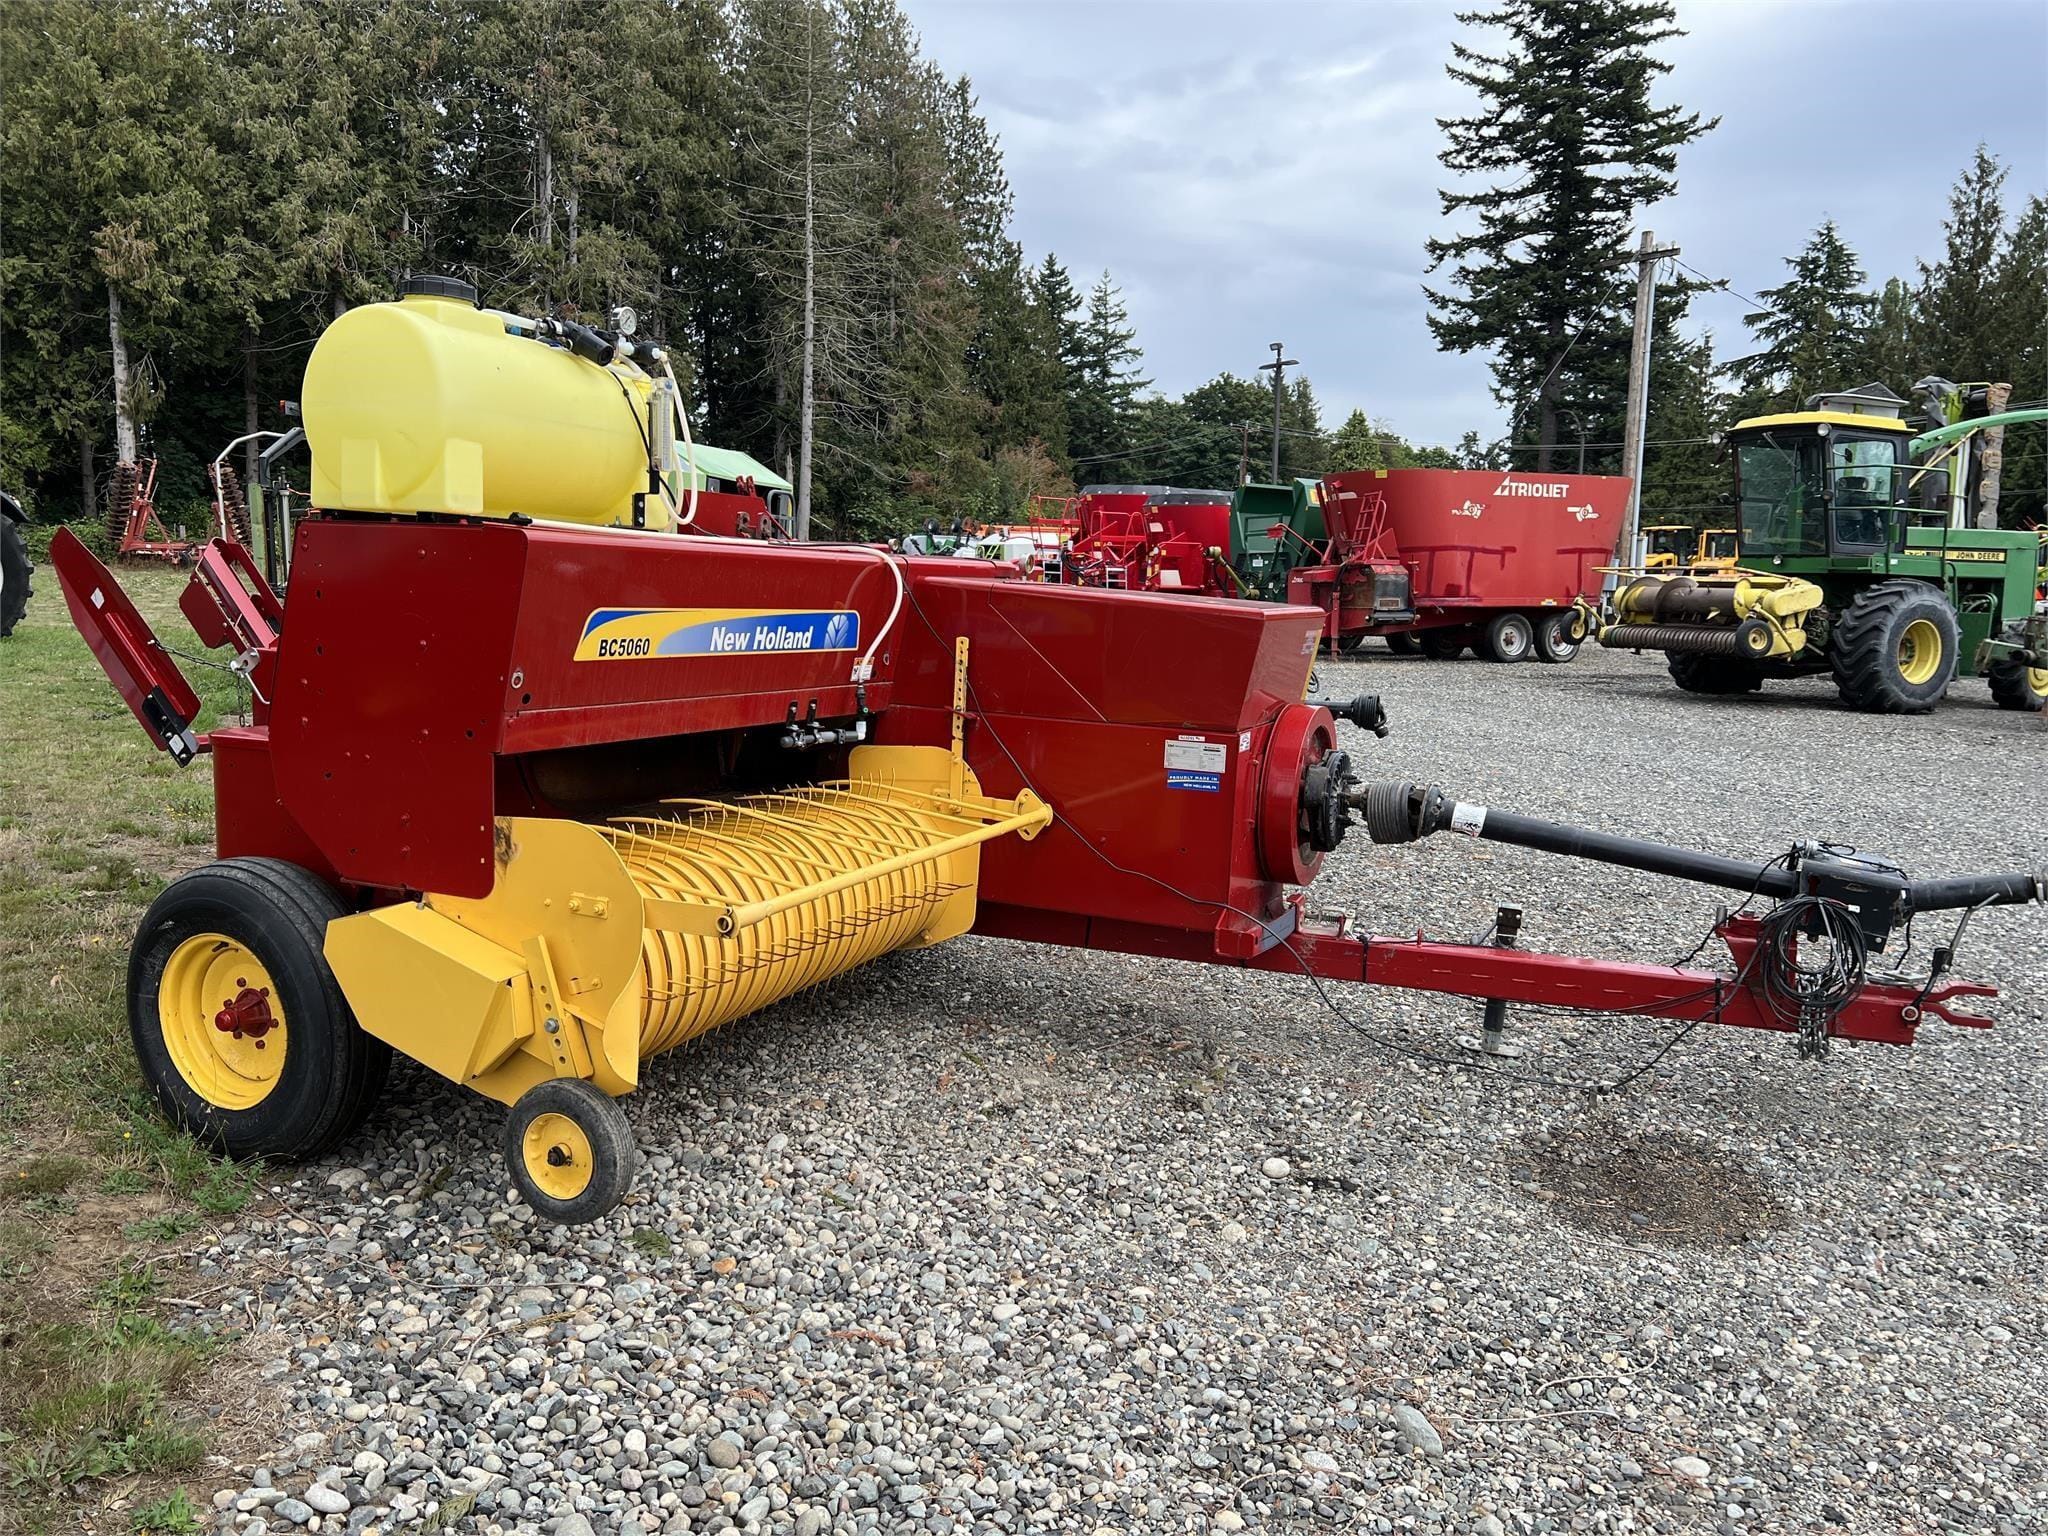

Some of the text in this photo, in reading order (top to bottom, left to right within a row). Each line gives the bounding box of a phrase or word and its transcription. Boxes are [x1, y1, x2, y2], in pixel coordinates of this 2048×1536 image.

[1510, 482, 1569, 497] TRIOLIET
[1977, 552, 2000, 560] DEERE
[710, 626, 813, 651] New Holland
[598, 638, 650, 656] BC5060
